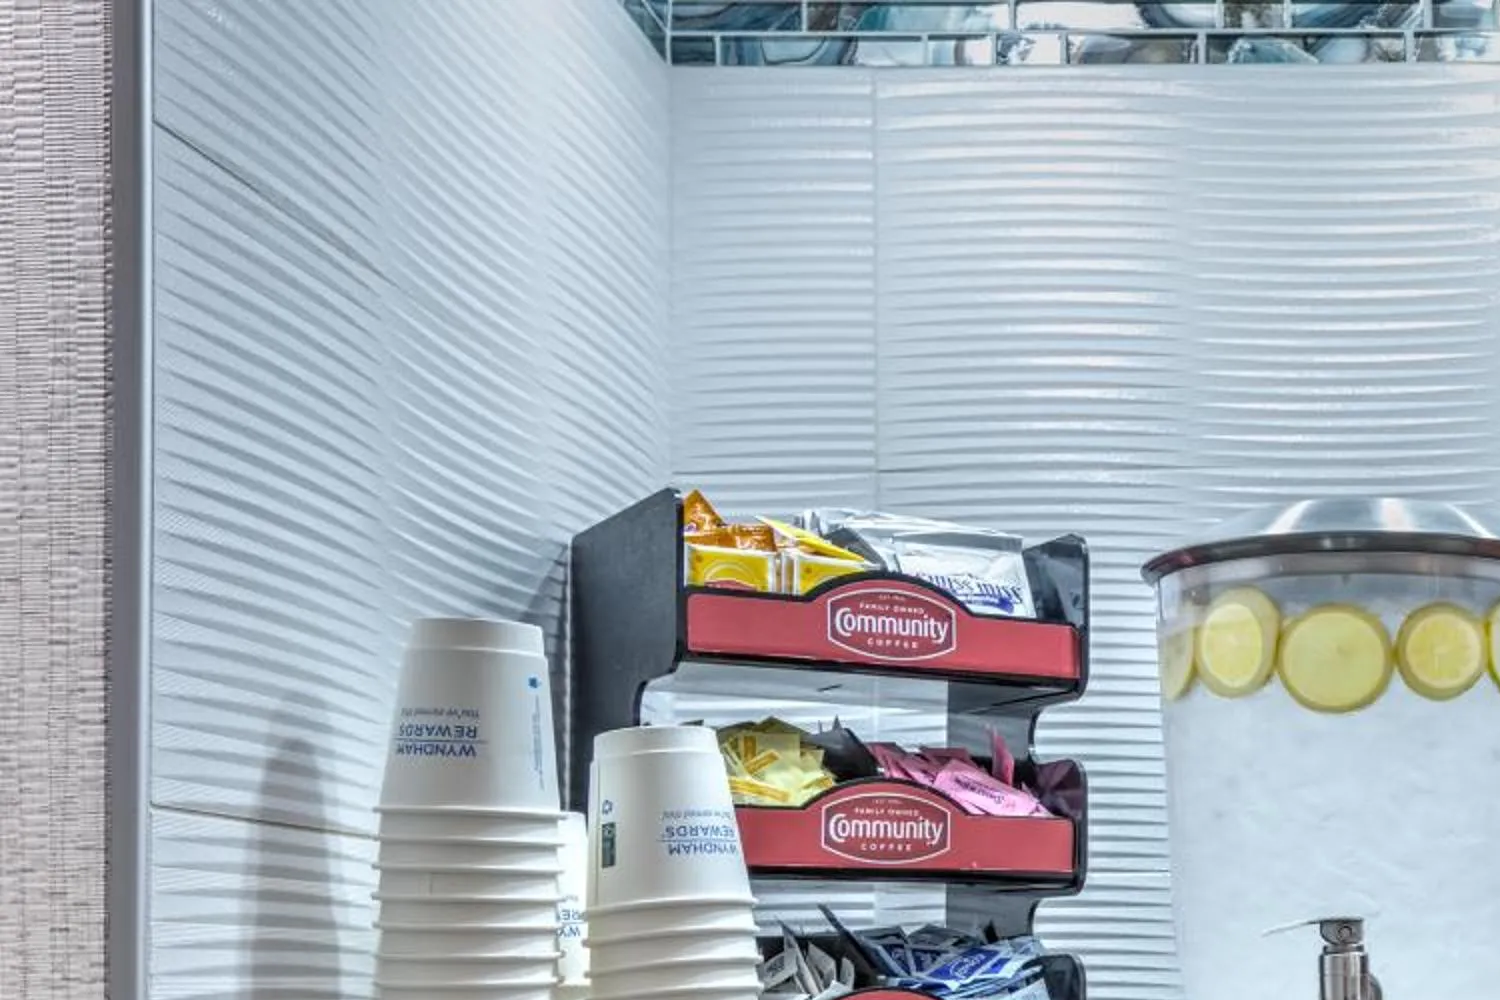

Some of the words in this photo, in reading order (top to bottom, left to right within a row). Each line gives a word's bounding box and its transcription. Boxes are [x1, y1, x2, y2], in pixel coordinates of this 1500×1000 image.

[835, 607, 949, 644] Community
[867, 637, 919, 649] COFFEE
[399, 723, 477, 739] REWARDS
[829, 813, 944, 846] Community
[860, 843, 912, 852] COFFEE
